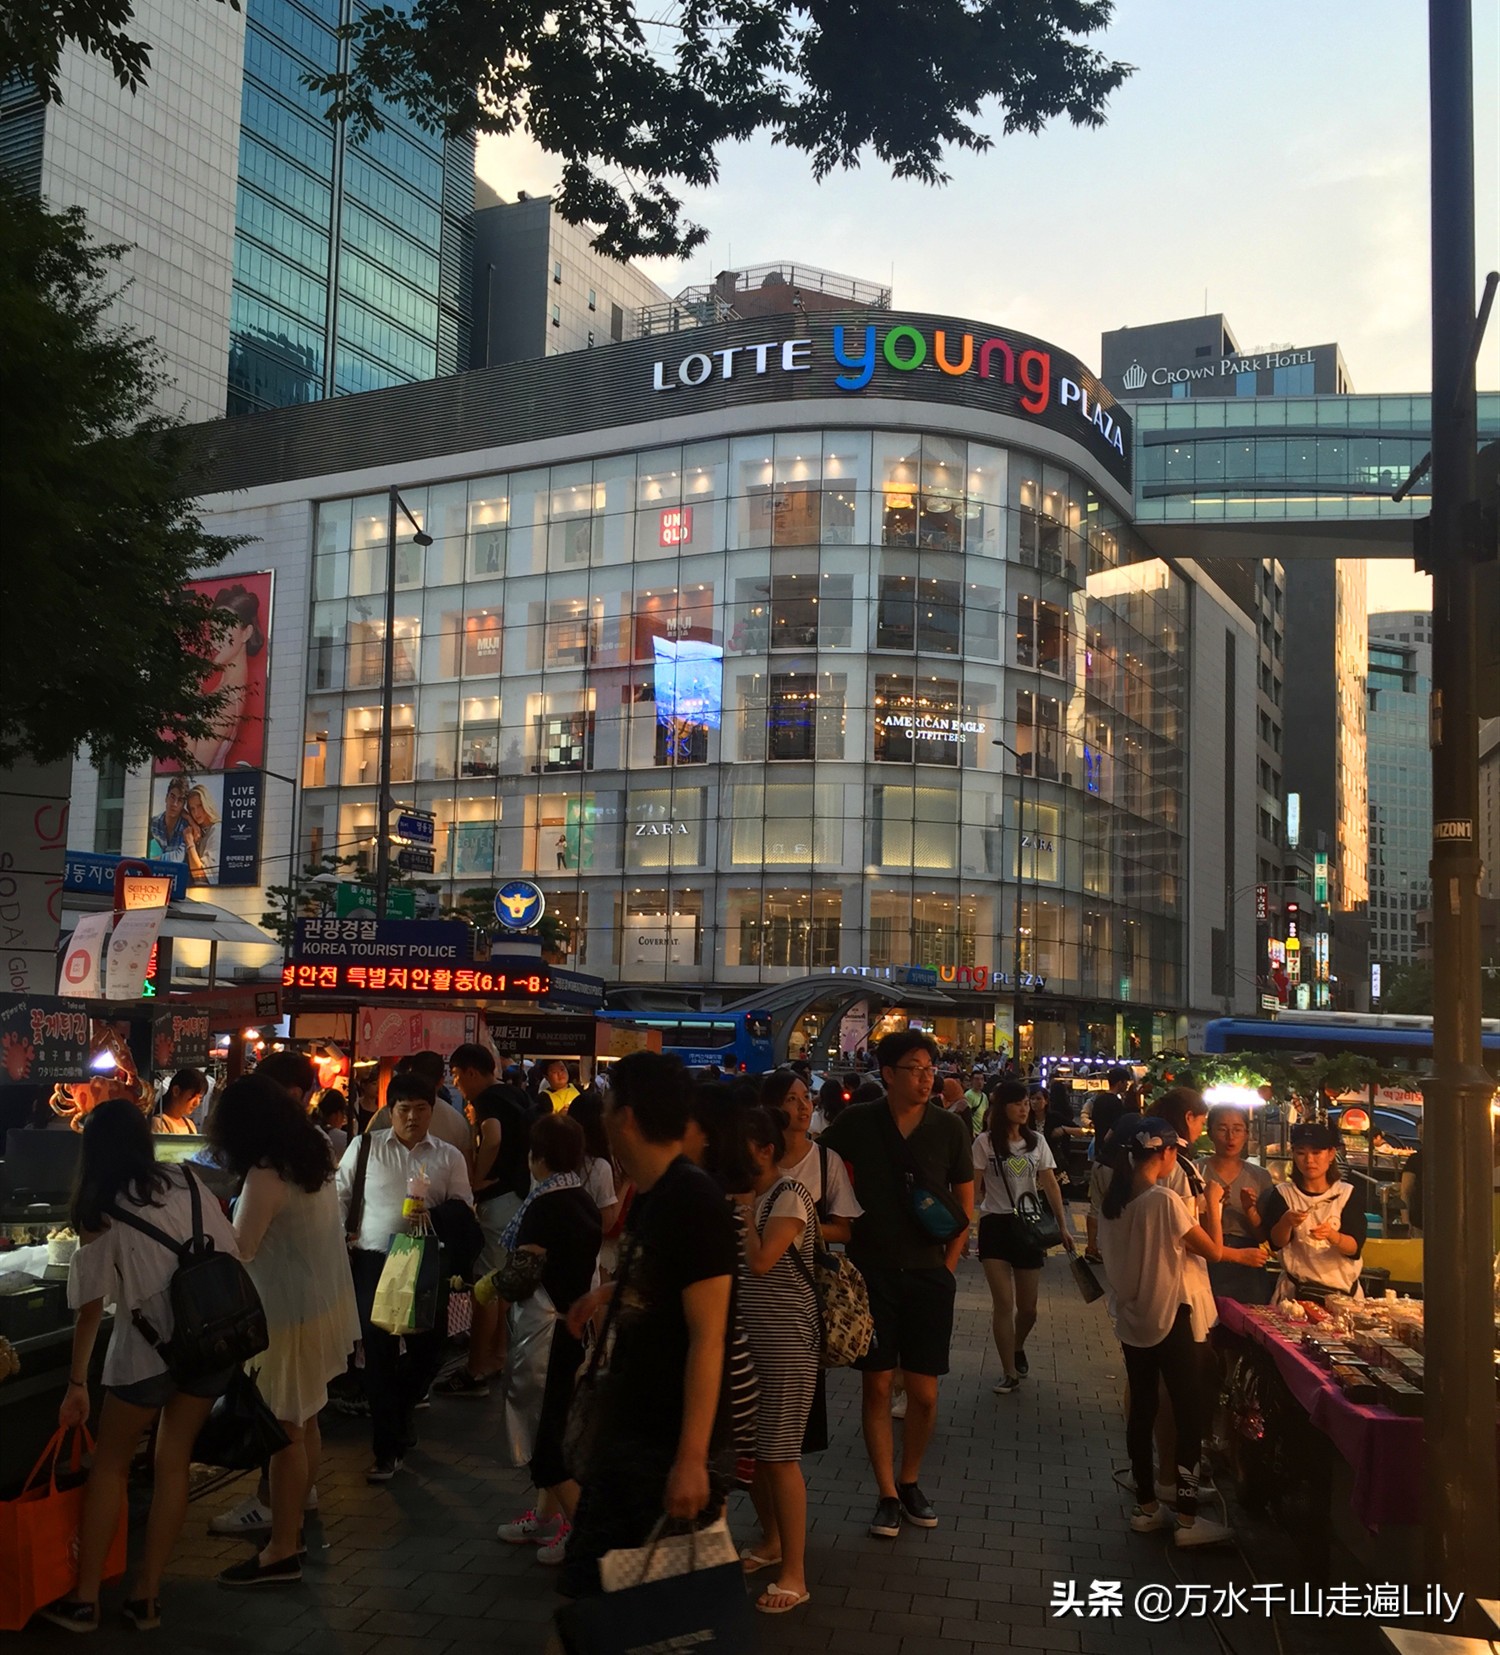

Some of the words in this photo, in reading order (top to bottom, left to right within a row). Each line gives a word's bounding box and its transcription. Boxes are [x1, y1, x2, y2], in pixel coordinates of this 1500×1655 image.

[1151, 365, 1215, 386] CROWN
[1220, 359, 1262, 377] PARK
[1266, 350, 1316, 370] HOTEL
[652, 337, 812, 392] LOTTE
[833, 323, 1053, 414] young
[1059, 376, 1126, 456] PLAZA
[663, 512, 687, 528] UNI
[662, 526, 689, 545] QLO
[667, 616, 692, 631] MUJI
[477, 638, 500, 650] MUJI
[231, 786, 255, 796] LIVE
[228, 797, 257, 808] YOUR
[231, 809, 254, 819] LIFE
[635, 823, 690, 837] ZARA
[304, 919, 379, 941] 관광경찰
[302, 941, 347, 955] KOREA
[352, 943, 407, 957] TOURIST
[409, 945, 457, 958] POLICE
[31, 1008, 88, 1046] 꽃게튀김
